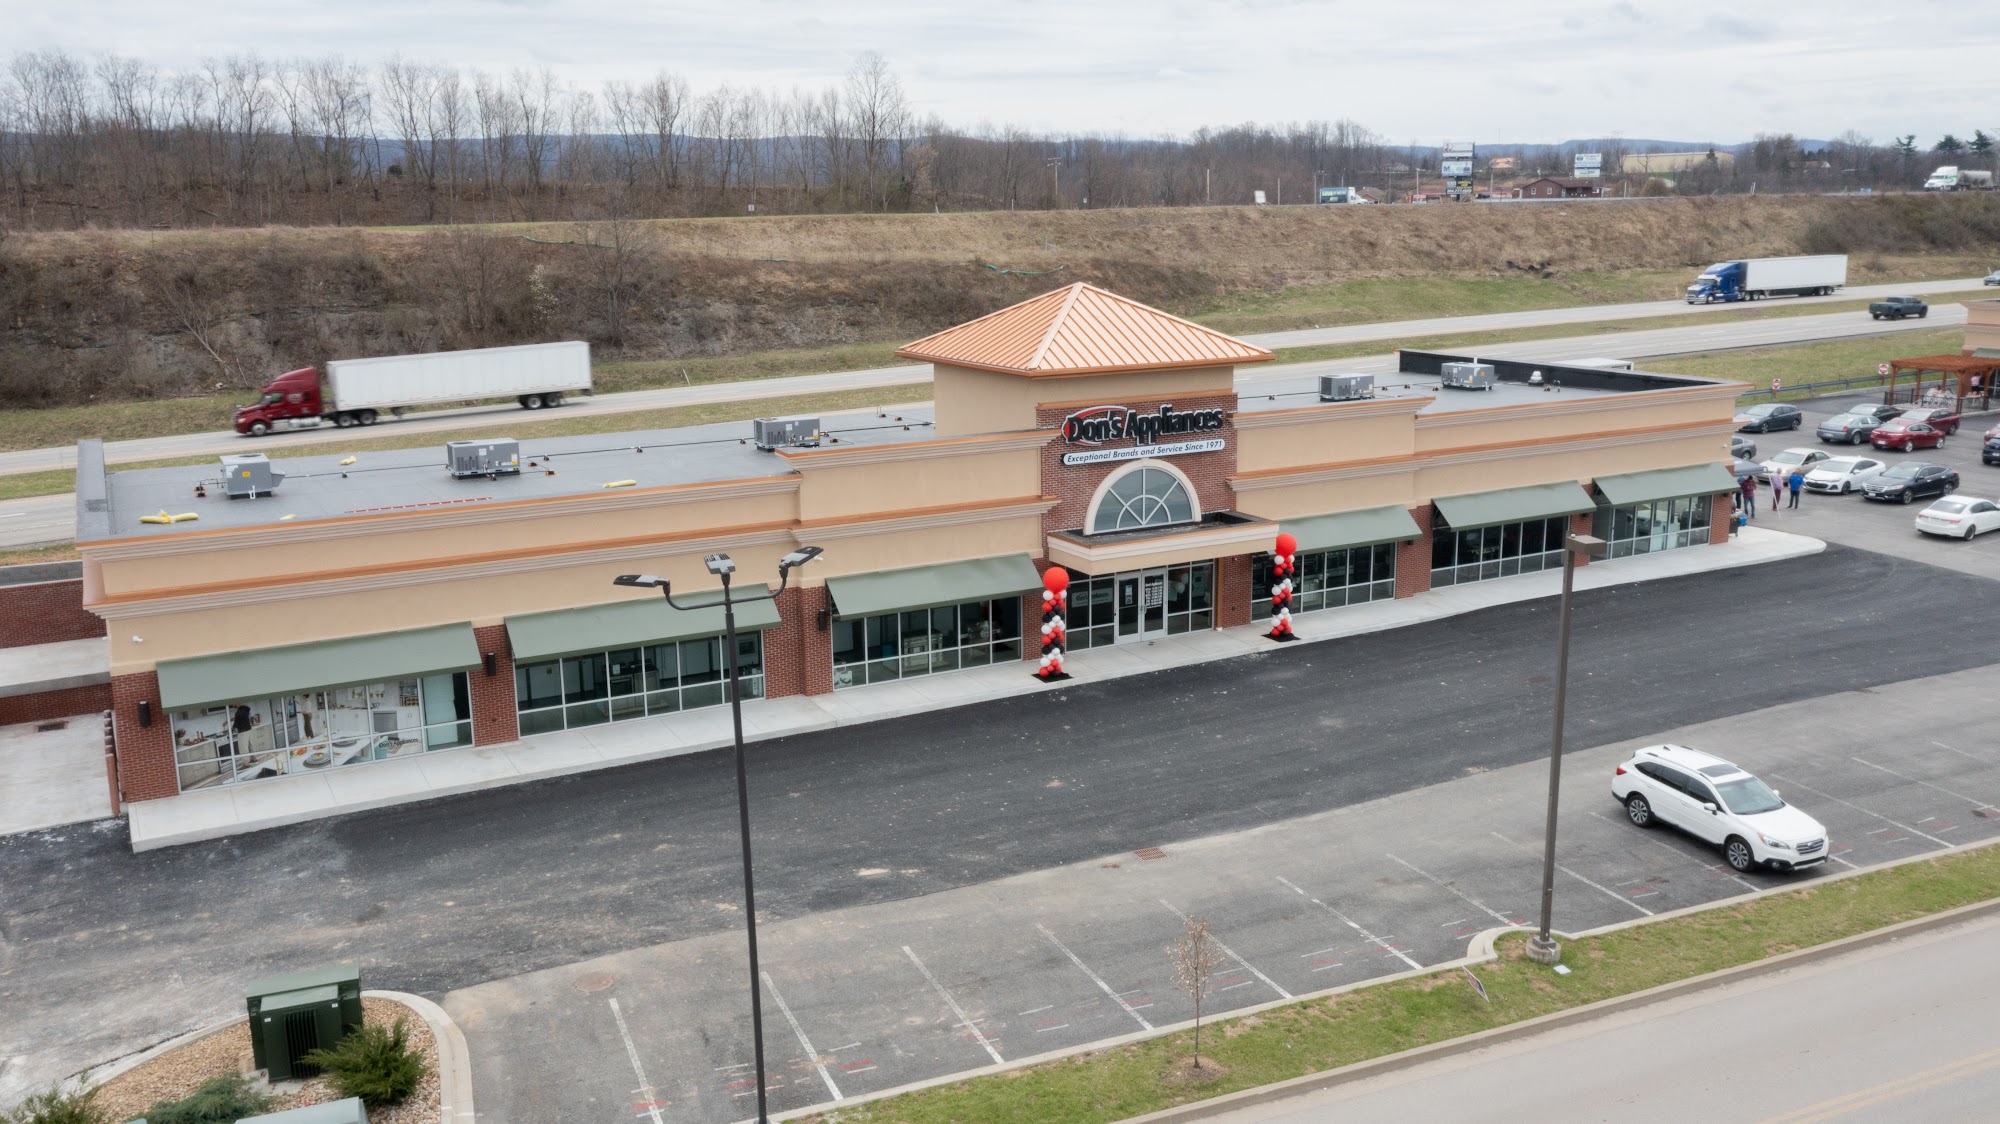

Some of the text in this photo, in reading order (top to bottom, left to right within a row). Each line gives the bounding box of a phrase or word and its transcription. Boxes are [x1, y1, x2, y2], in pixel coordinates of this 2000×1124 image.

[1066, 404, 1223, 445] Don's Appliances
[1067, 440, 1223, 463] Exceptional Brands and Service Since 1971
